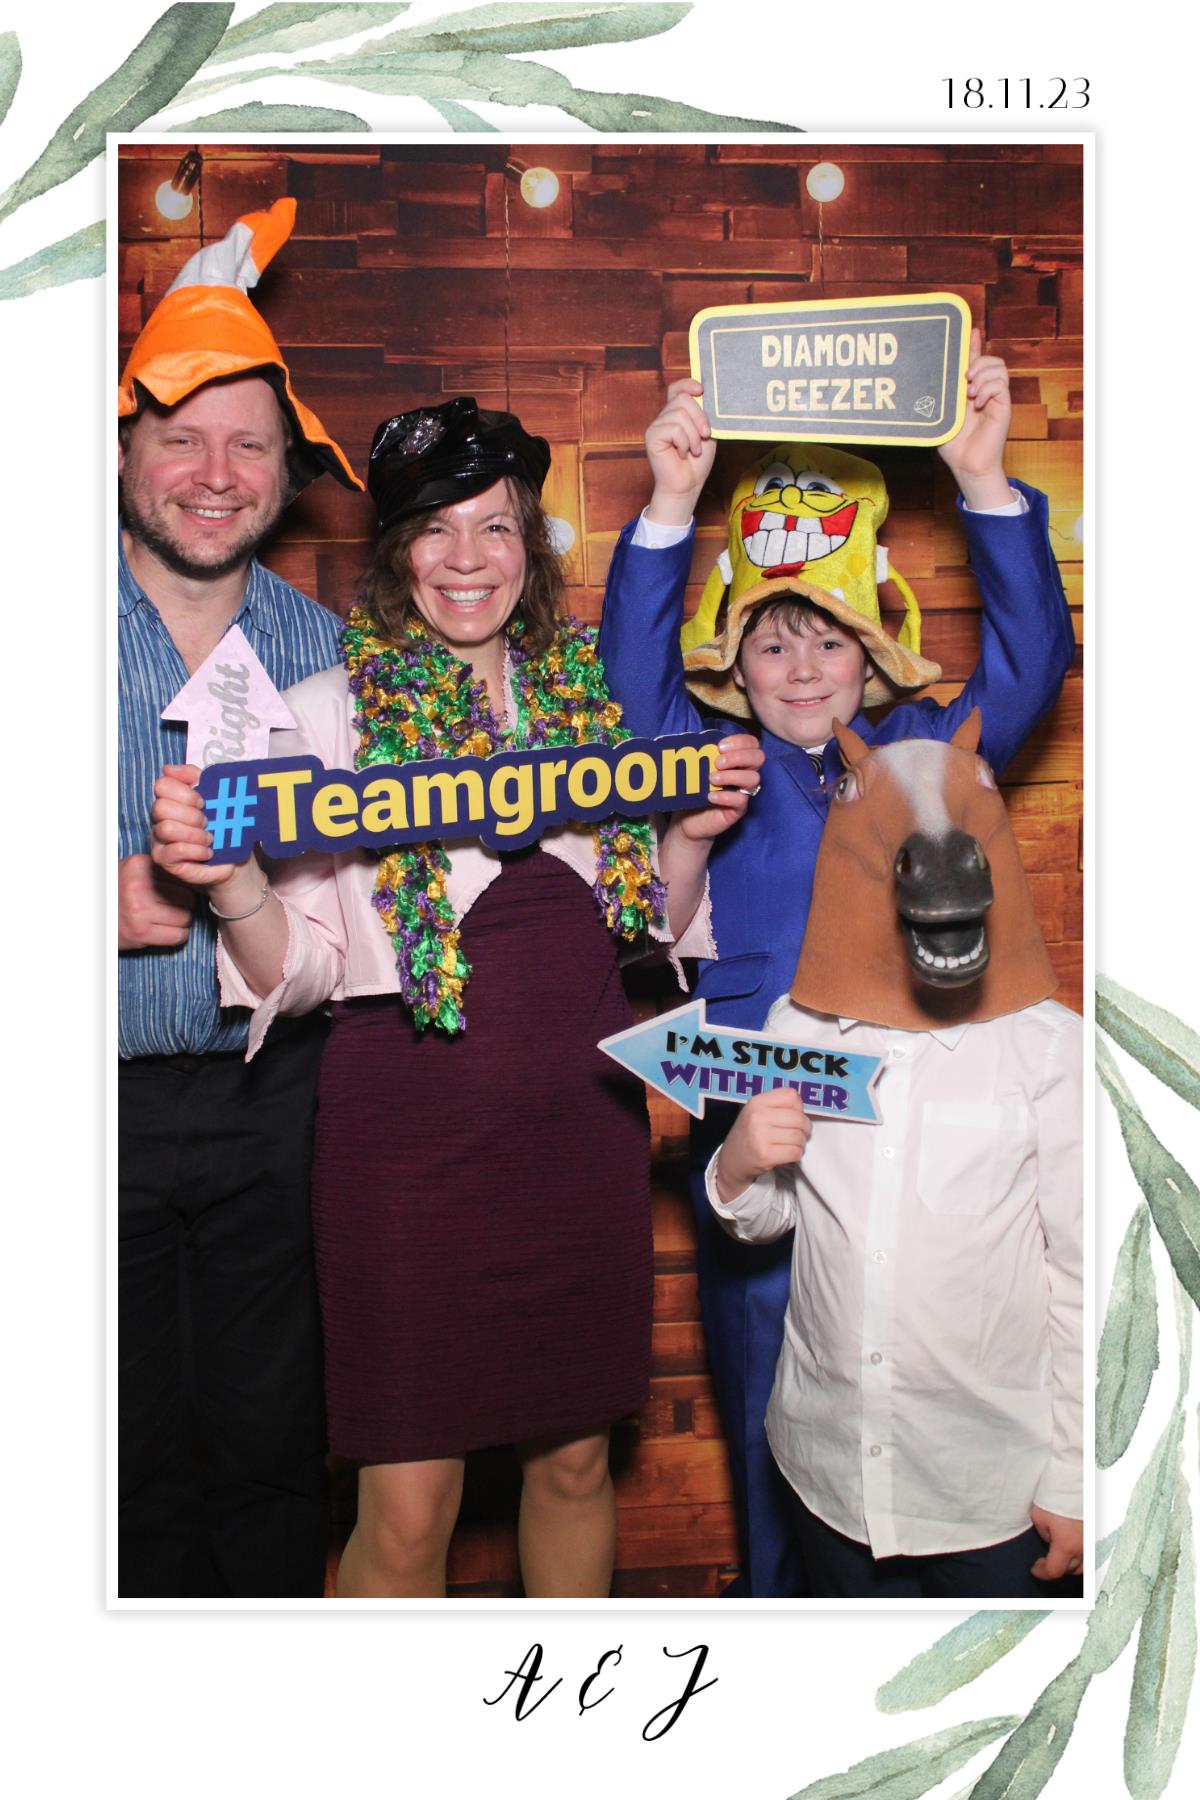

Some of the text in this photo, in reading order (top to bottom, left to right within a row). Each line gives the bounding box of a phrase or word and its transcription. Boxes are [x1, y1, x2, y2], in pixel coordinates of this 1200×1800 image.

[762, 333, 898, 367] DIAMOND
[766, 377, 897, 412] GEEZER
[205, 744, 722, 850] #Teamgroom
[666, 1031, 848, 1079] I'M STUCK
[660, 1061, 763, 1097] WITH
